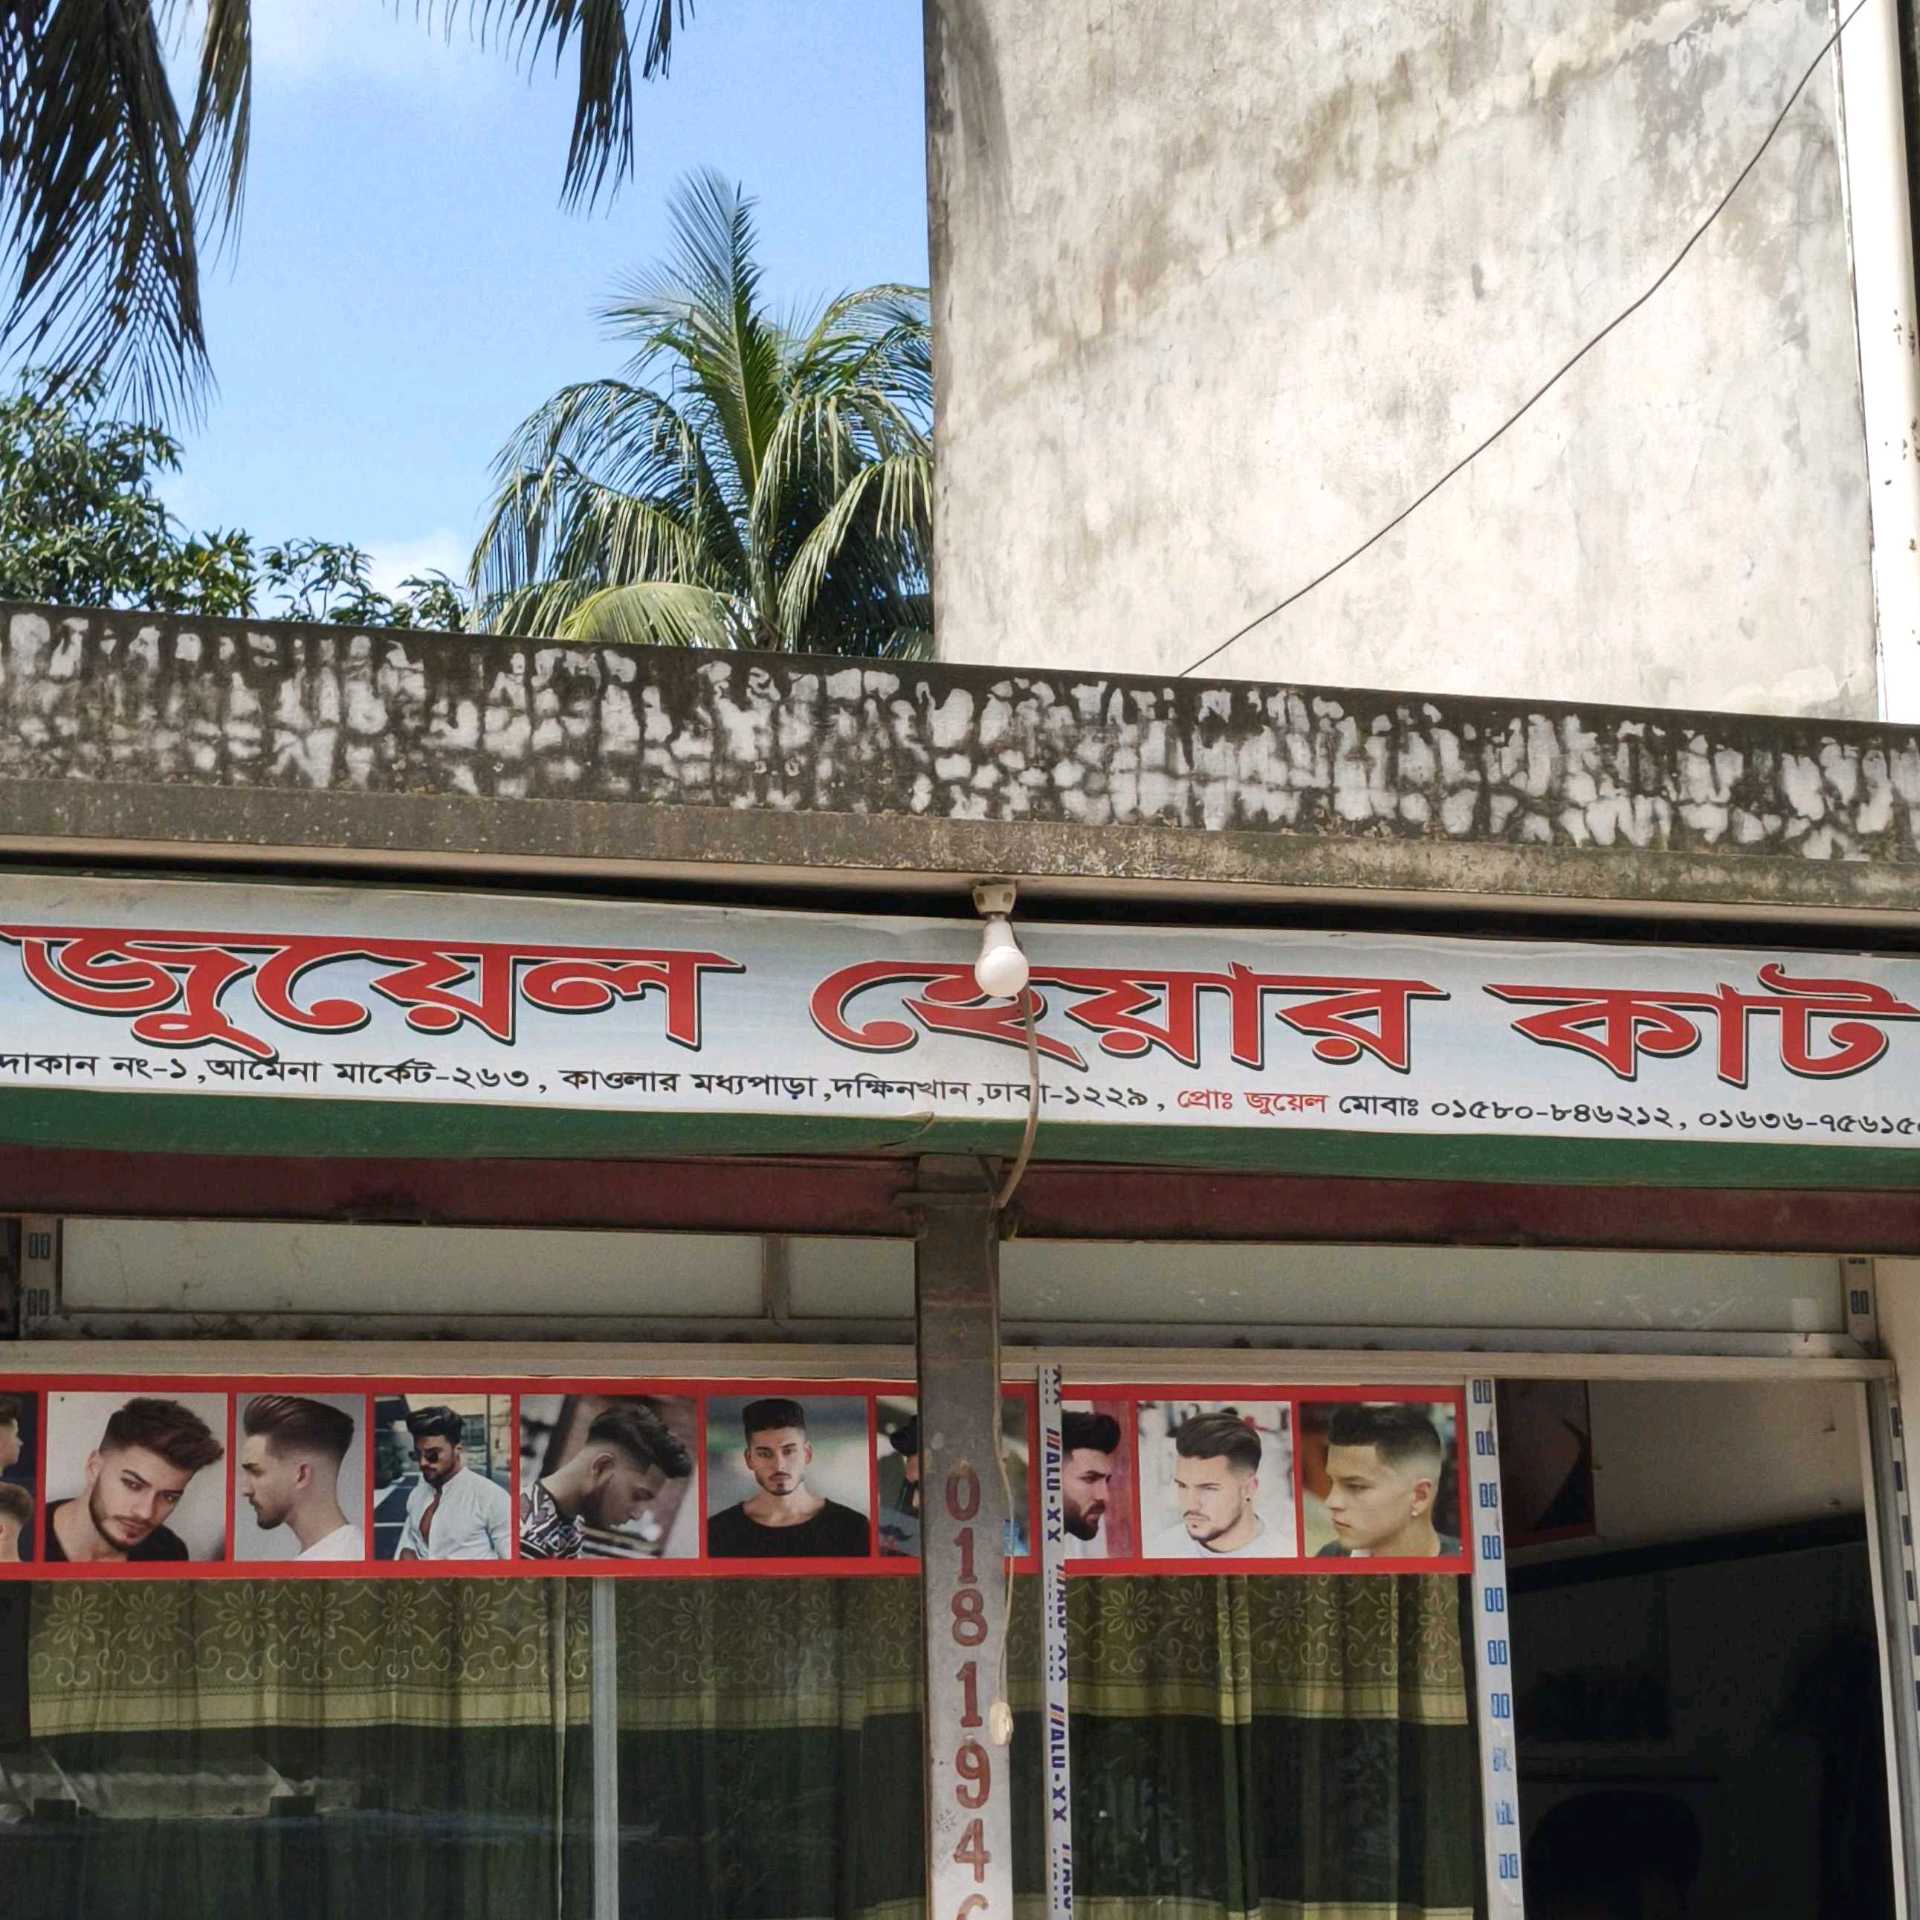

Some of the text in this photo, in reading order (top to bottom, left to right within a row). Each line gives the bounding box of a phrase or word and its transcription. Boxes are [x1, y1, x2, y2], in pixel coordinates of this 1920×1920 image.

[0, 924, 1920, 1089] জুয়েল হেয়ার কাট
[0, 1052, 100, 1076] দাকান
[110, 1055, 188, 1080] নং-১
[559, 1070, 680, 1093] কাওলার
[690, 1073, 819, 1100] মধ্যপাড়া
[1177, 1088, 1233, 1110] প্রোঃ
[1243, 1091, 1330, 1116] জুয়েল
[1339, 1095, 1419, 1117] মোবাঃ
[1699, 1109, 1920, 1135] ০১৬৩৬-৭৫৬১৫
